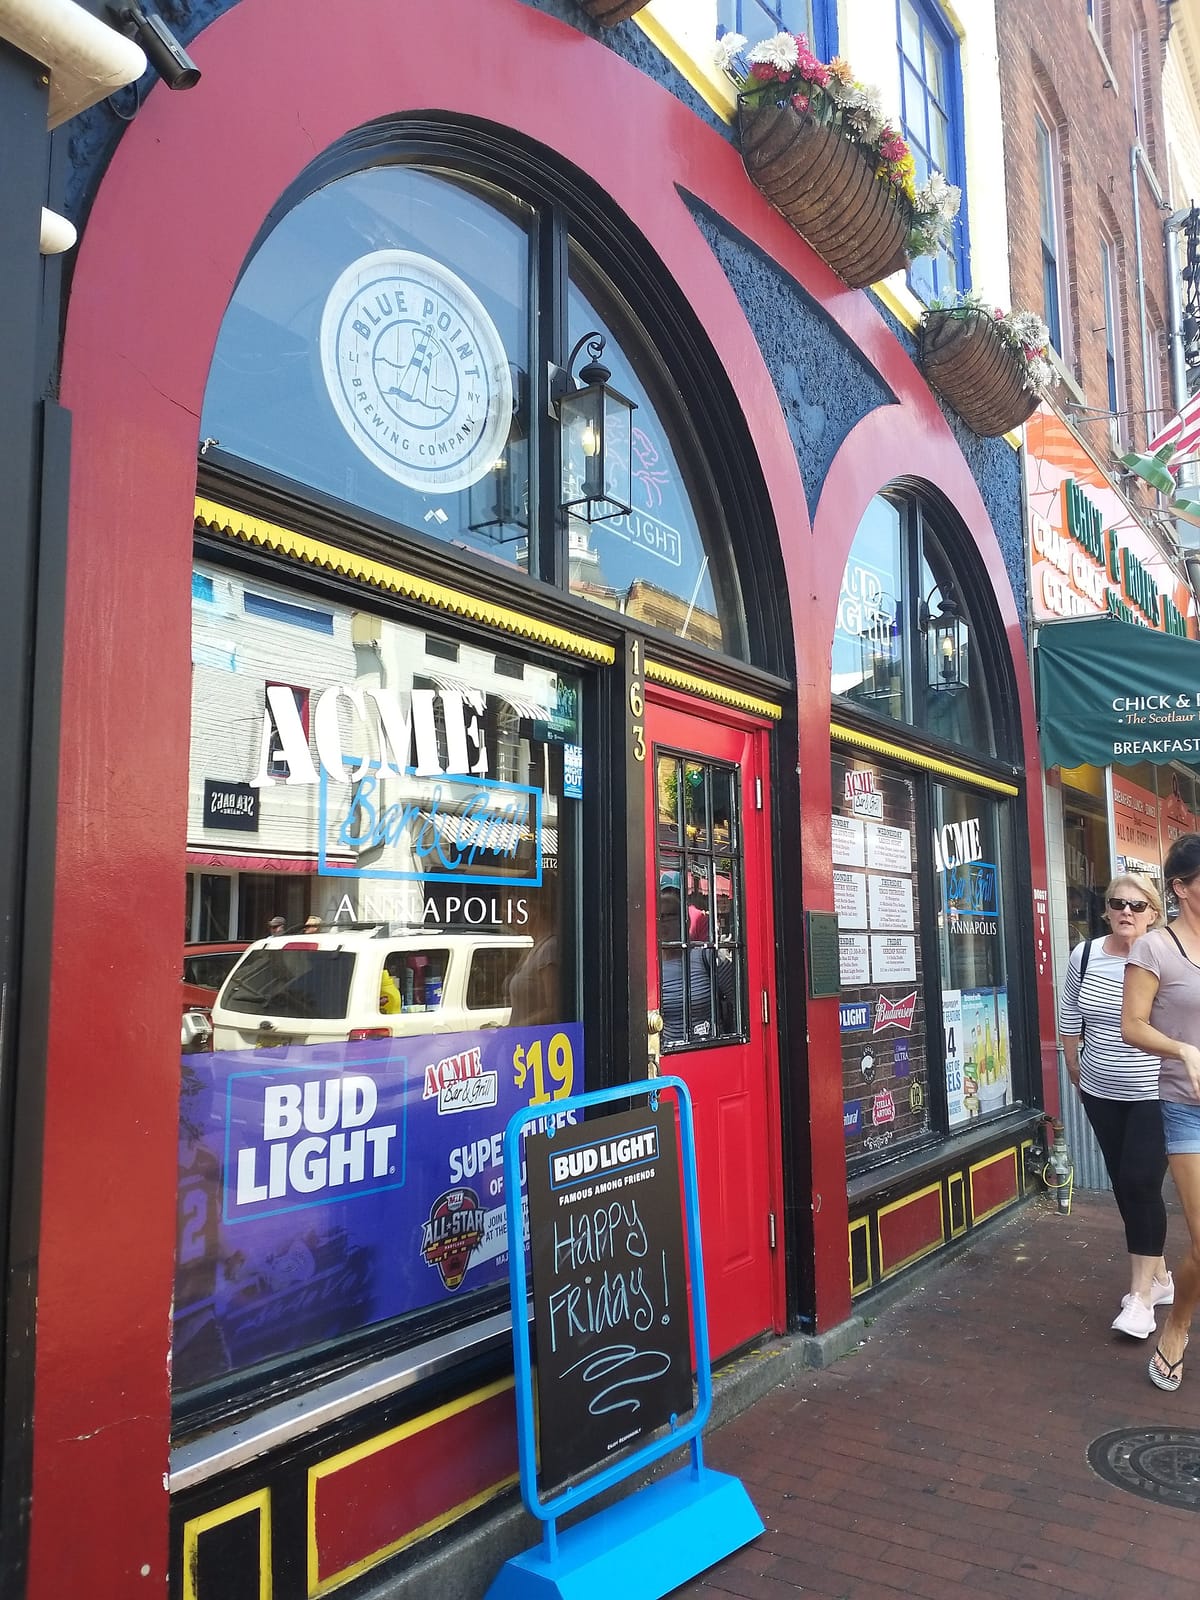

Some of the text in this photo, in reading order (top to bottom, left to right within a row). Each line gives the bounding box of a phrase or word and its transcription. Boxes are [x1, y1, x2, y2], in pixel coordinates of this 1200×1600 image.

[352, 290, 481, 379] BLUE POINT
[467, 391, 481, 404] NY
[352, 378, 477, 456] BREWING COMPANY
[1067, 479, 1105, 567] CHICK
[1108, 530, 1121, 585] &
[630, 640, 646, 761] 163
[1112, 694, 1172, 712] CHICK
[1175, 693, 1191, 708] &
[1125, 710, 1196, 724] The Scotlaur
[249, 685, 488, 788] ACME
[1113, 738, 1200, 755] BREAKFAST
[564, 775, 582, 786] OUT
[337, 776, 529, 870] Bar & Grill
[933, 818, 983, 873] ACME
[334, 893, 529, 924] ANNAPOLIS
[950, 921, 997, 935] ANNAPOLIS
[842, 1007, 867, 1026] LIGHT
[424, 1049, 481, 1097] ACME
[512, 1032, 574, 1106] $19
[894, 1052, 908, 1062] ULTRA
[443, 1083, 463, 1104] Bar
[472, 1078, 491, 1101] Grill
[876, 1100, 891, 1109] STELLA
[263, 1075, 378, 1141] BUD
[876, 1107, 892, 1118] ARTOIS
[236, 1124, 397, 1206] LIGHT
[449, 1132, 506, 1184] SUPE
[553, 1148, 599, 1182] BUD
[600, 1132, 656, 1169] LIGHT
[489, 1178, 503, 1196] OF
[558, 1168, 655, 1206] FAMOUS AMONG FRIENDS
[425, 1209, 484, 1244] ALL STAR
[485, 1225, 507, 1242] AT THE
[488, 1215, 503, 1228] JOIN
